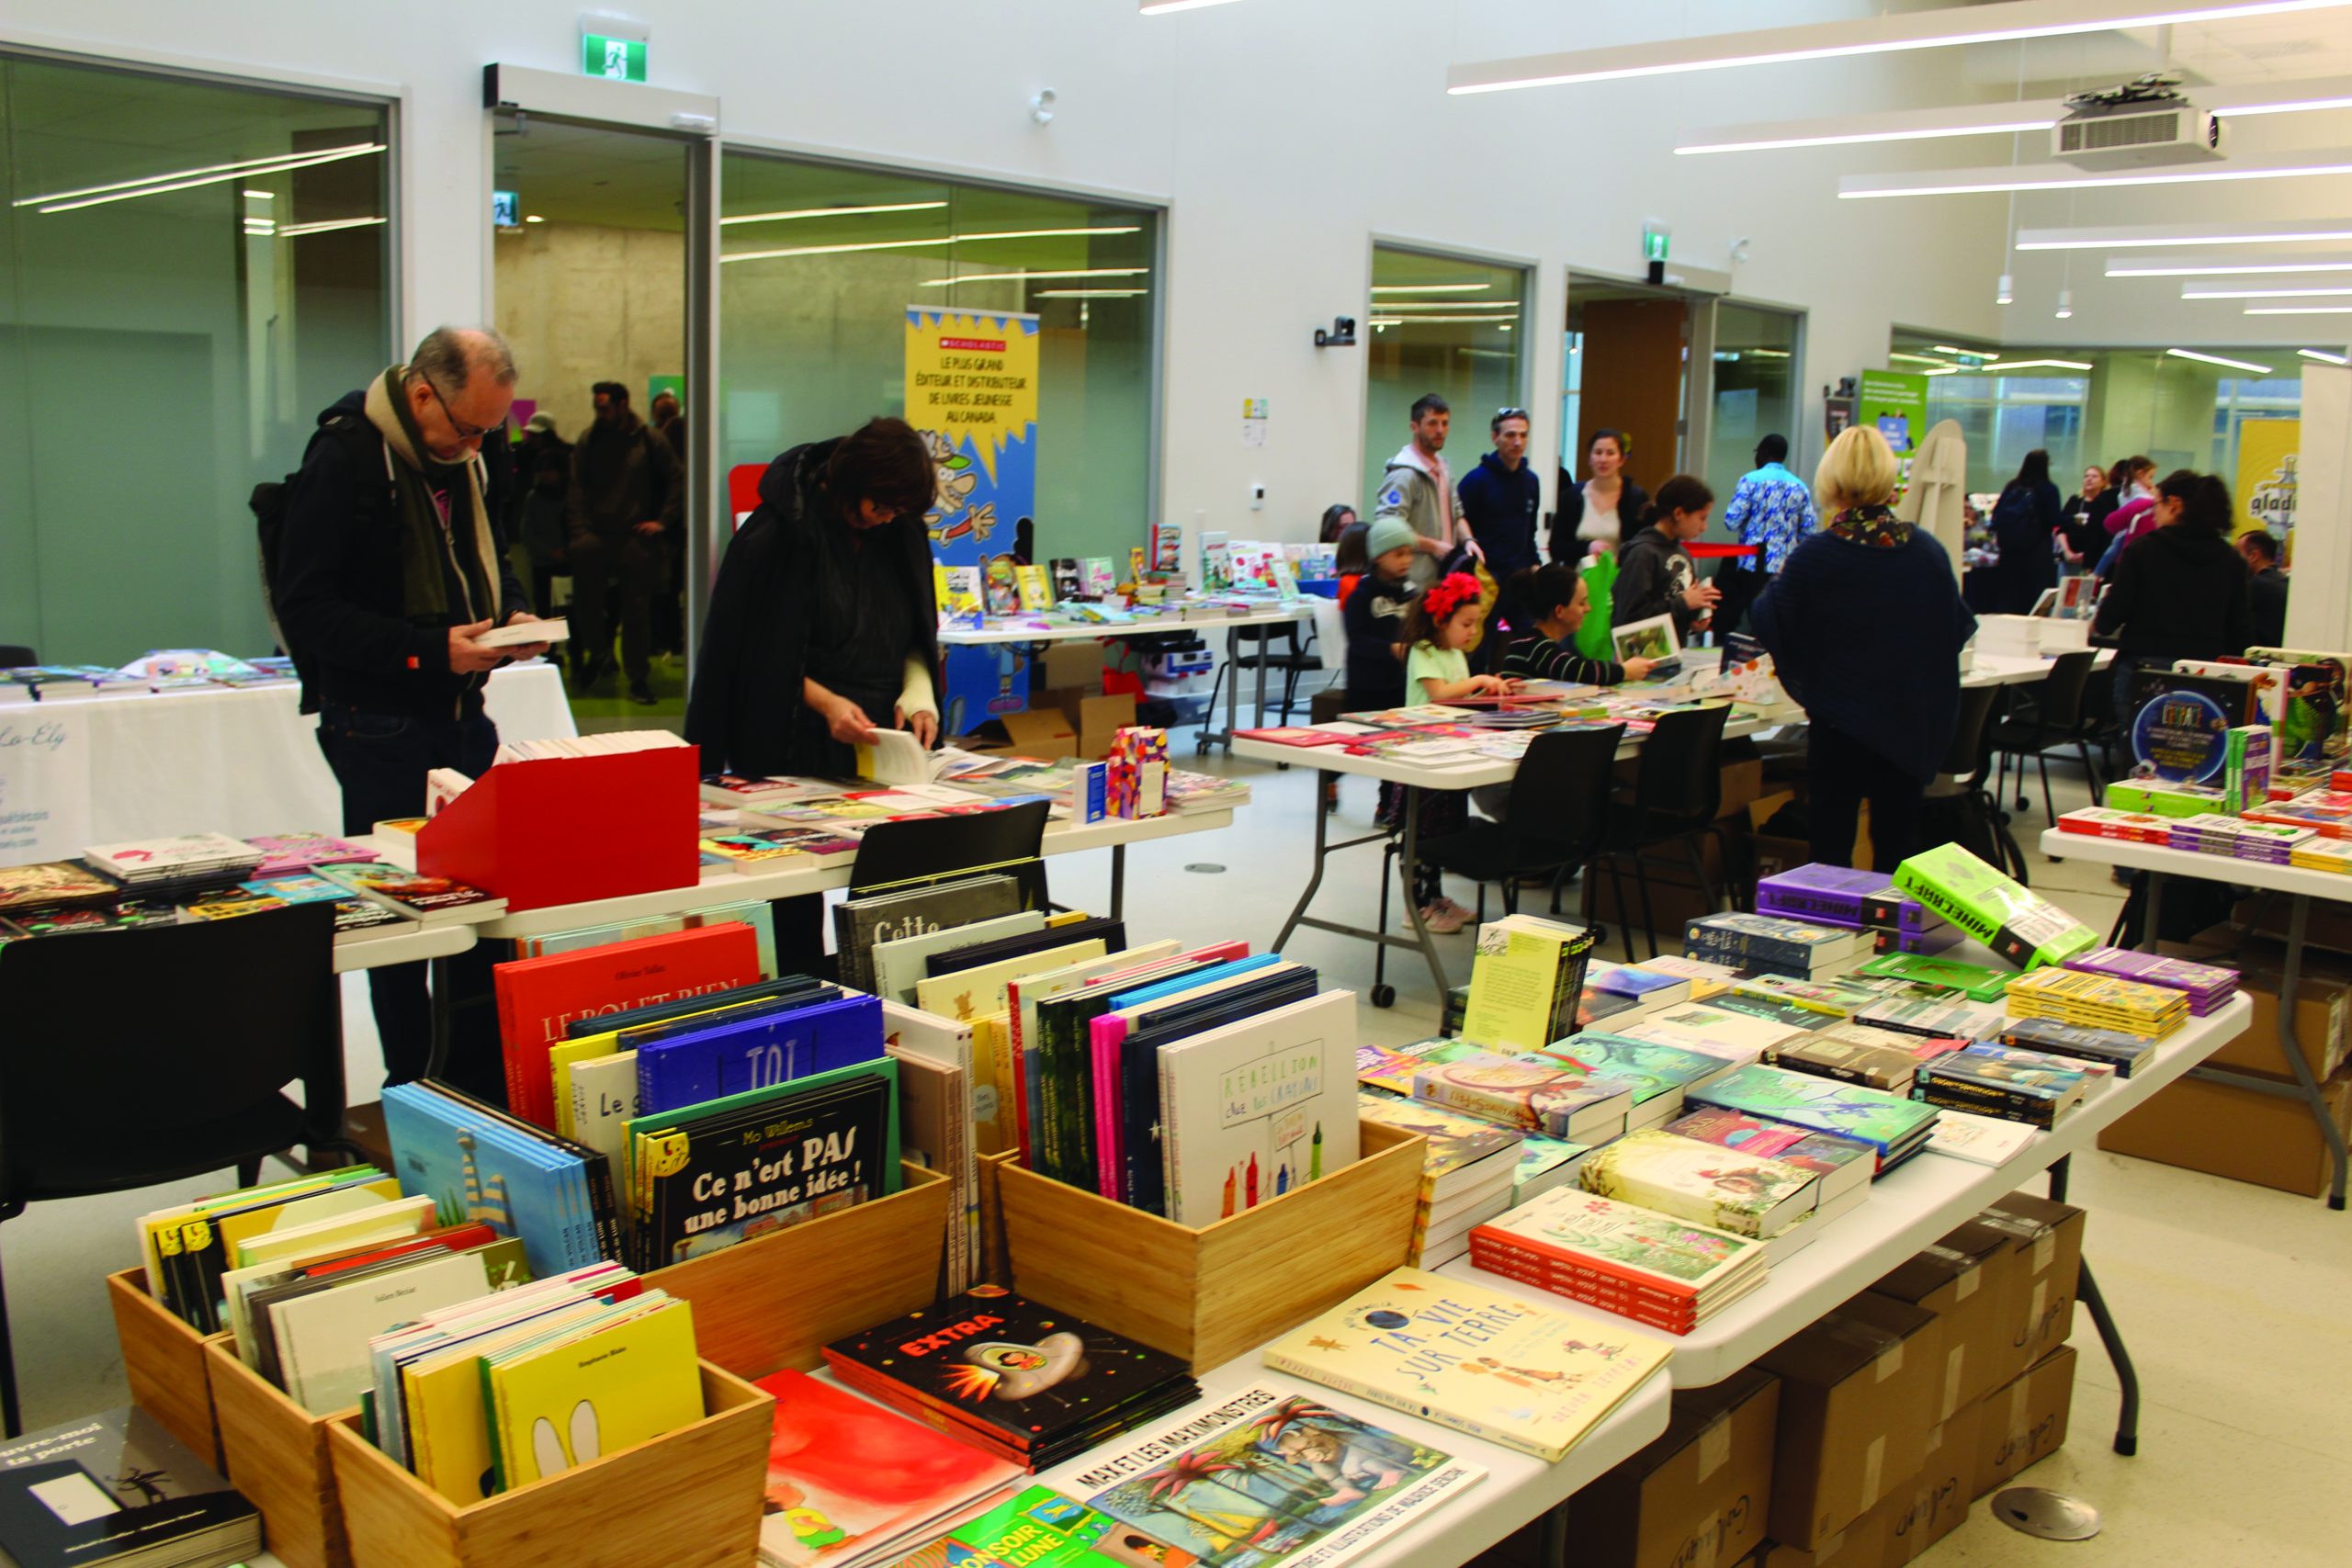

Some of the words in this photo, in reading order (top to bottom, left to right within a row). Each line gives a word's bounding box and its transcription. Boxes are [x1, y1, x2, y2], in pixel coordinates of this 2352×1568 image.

[950, 339, 1006, 351] SCHOLASTIC
[941, 357, 950, 368] LE
[950, 358, 972, 369] PLUS
[974, 359, 1003, 370] GRAND
[916, 372, 952, 387] ÉDITEUR
[955, 375, 966, 387] ET
[967, 377, 1026, 389] DISTRIBUTEUR
[929, 393, 939, 404] DE
[942, 394, 969, 405] LIVRES
[972, 395, 1012, 406] JEUNESSE
[945, 412, 958, 423] AU
[1768, 892, 1860, 917] MINECRAFT
[1905, 876, 1996, 939] MINECRAFT
[600, 1092, 624, 1118] Le
[742, 1129, 762, 1145] Mo
[764, 1118, 814, 1138] Willems
[693, 1171, 728, 1202] Ce
[734, 1149, 795, 1192] n'est
[801, 1125, 857, 1172] PAS
[684, 1207, 728, 1235] une
[733, 1185, 800, 1220] bonne
[806, 1169, 850, 1199] idée
[899, 1314, 1005, 1358] EXTRA
[1370, 1332, 1428, 1354] TA
[1416, 1299, 1475, 1325] VIE
[1396, 1349, 1463, 1381] SUR
[1440, 1304, 1523, 1348] TERRE
[6, 1449, 34, 1467] ta
[36, 1436, 96, 1461] porte
[1076, 1464, 1122, 1490] MAX
[1114, 1451, 1145, 1472] ET
[1138, 1442, 1170, 1462] LES
[1159, 1389, 1276, 1450] MAXIMONSTRES
[1327, 1512, 1393, 1552] ILLUSTRATIONS
[1385, 1504, 1405, 1517] DE
[1396, 1483, 1438, 1509] MAURICE
[1009, 1532, 1064, 1568] LUNE
